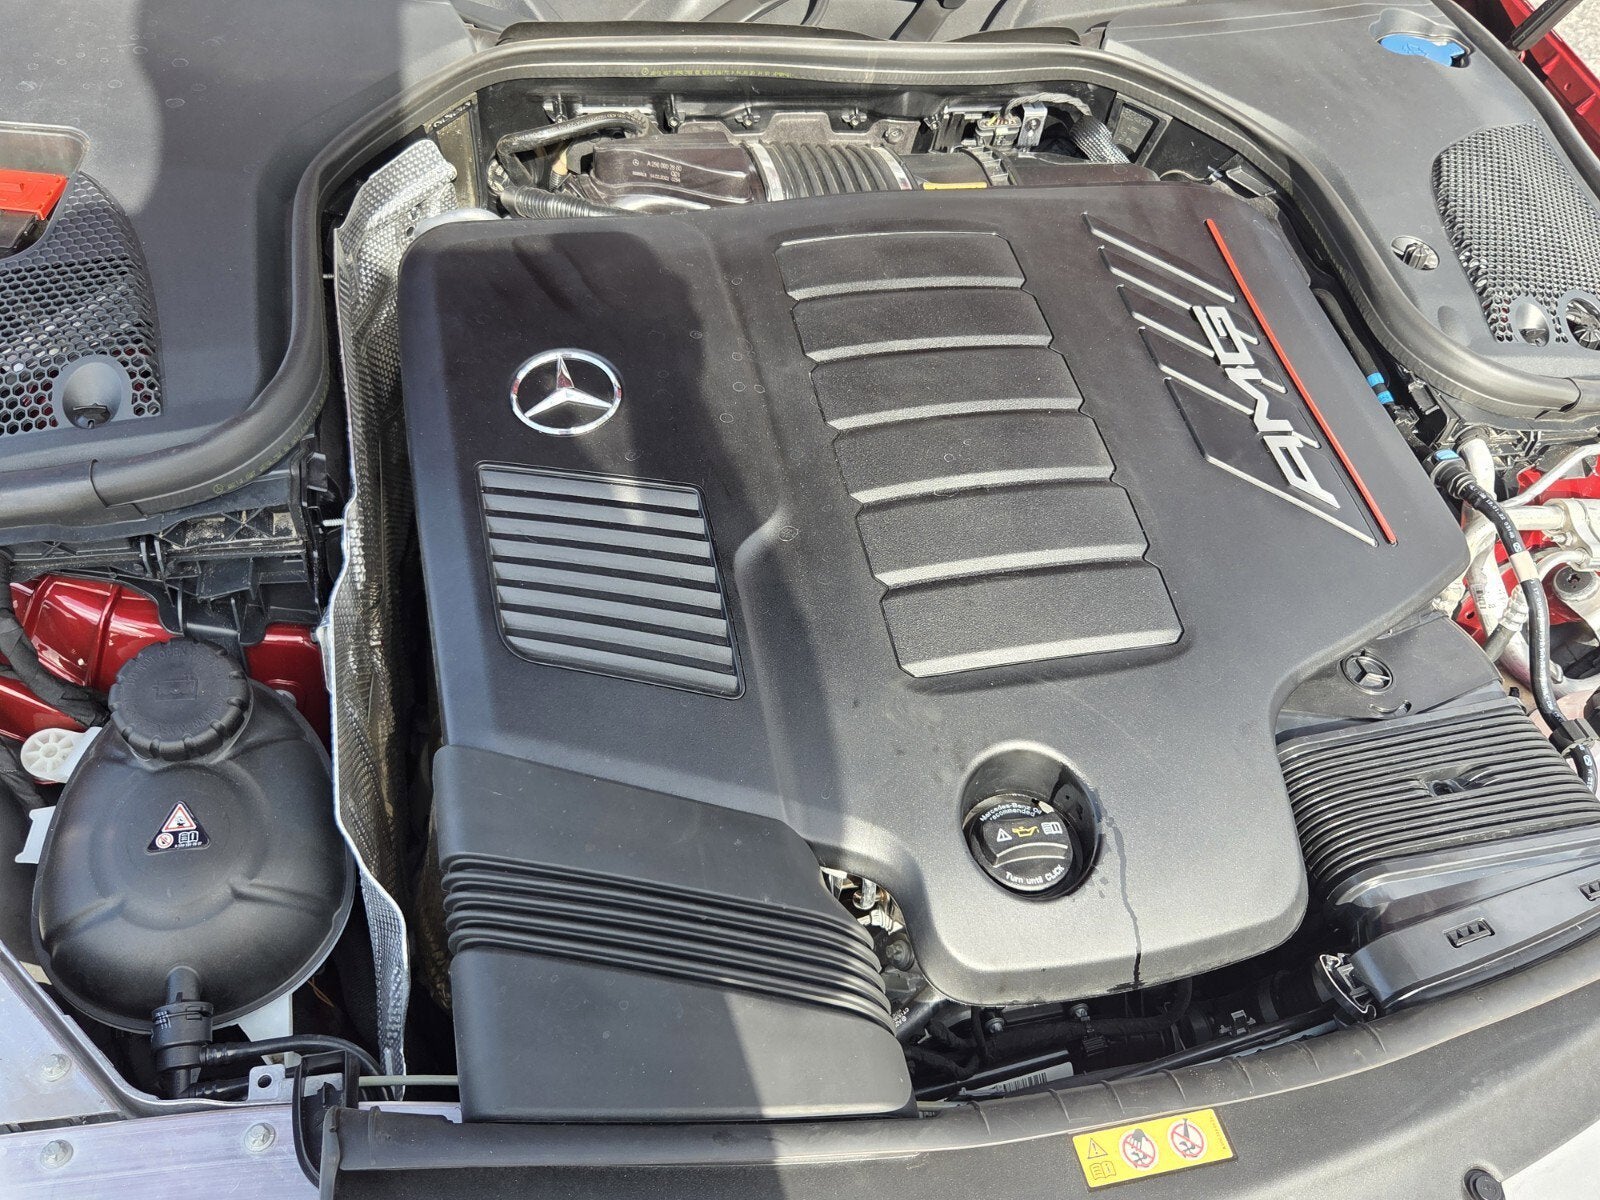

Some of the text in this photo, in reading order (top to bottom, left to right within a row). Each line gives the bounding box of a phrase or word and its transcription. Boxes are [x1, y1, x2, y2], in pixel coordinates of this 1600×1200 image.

[1192, 305, 1341, 509] AMG
[980, 802, 1031, 821] Mercedes-Benz
[990, 809, 1035, 820] recommended
[1005, 864, 1065, 885] Turn until CLICK
